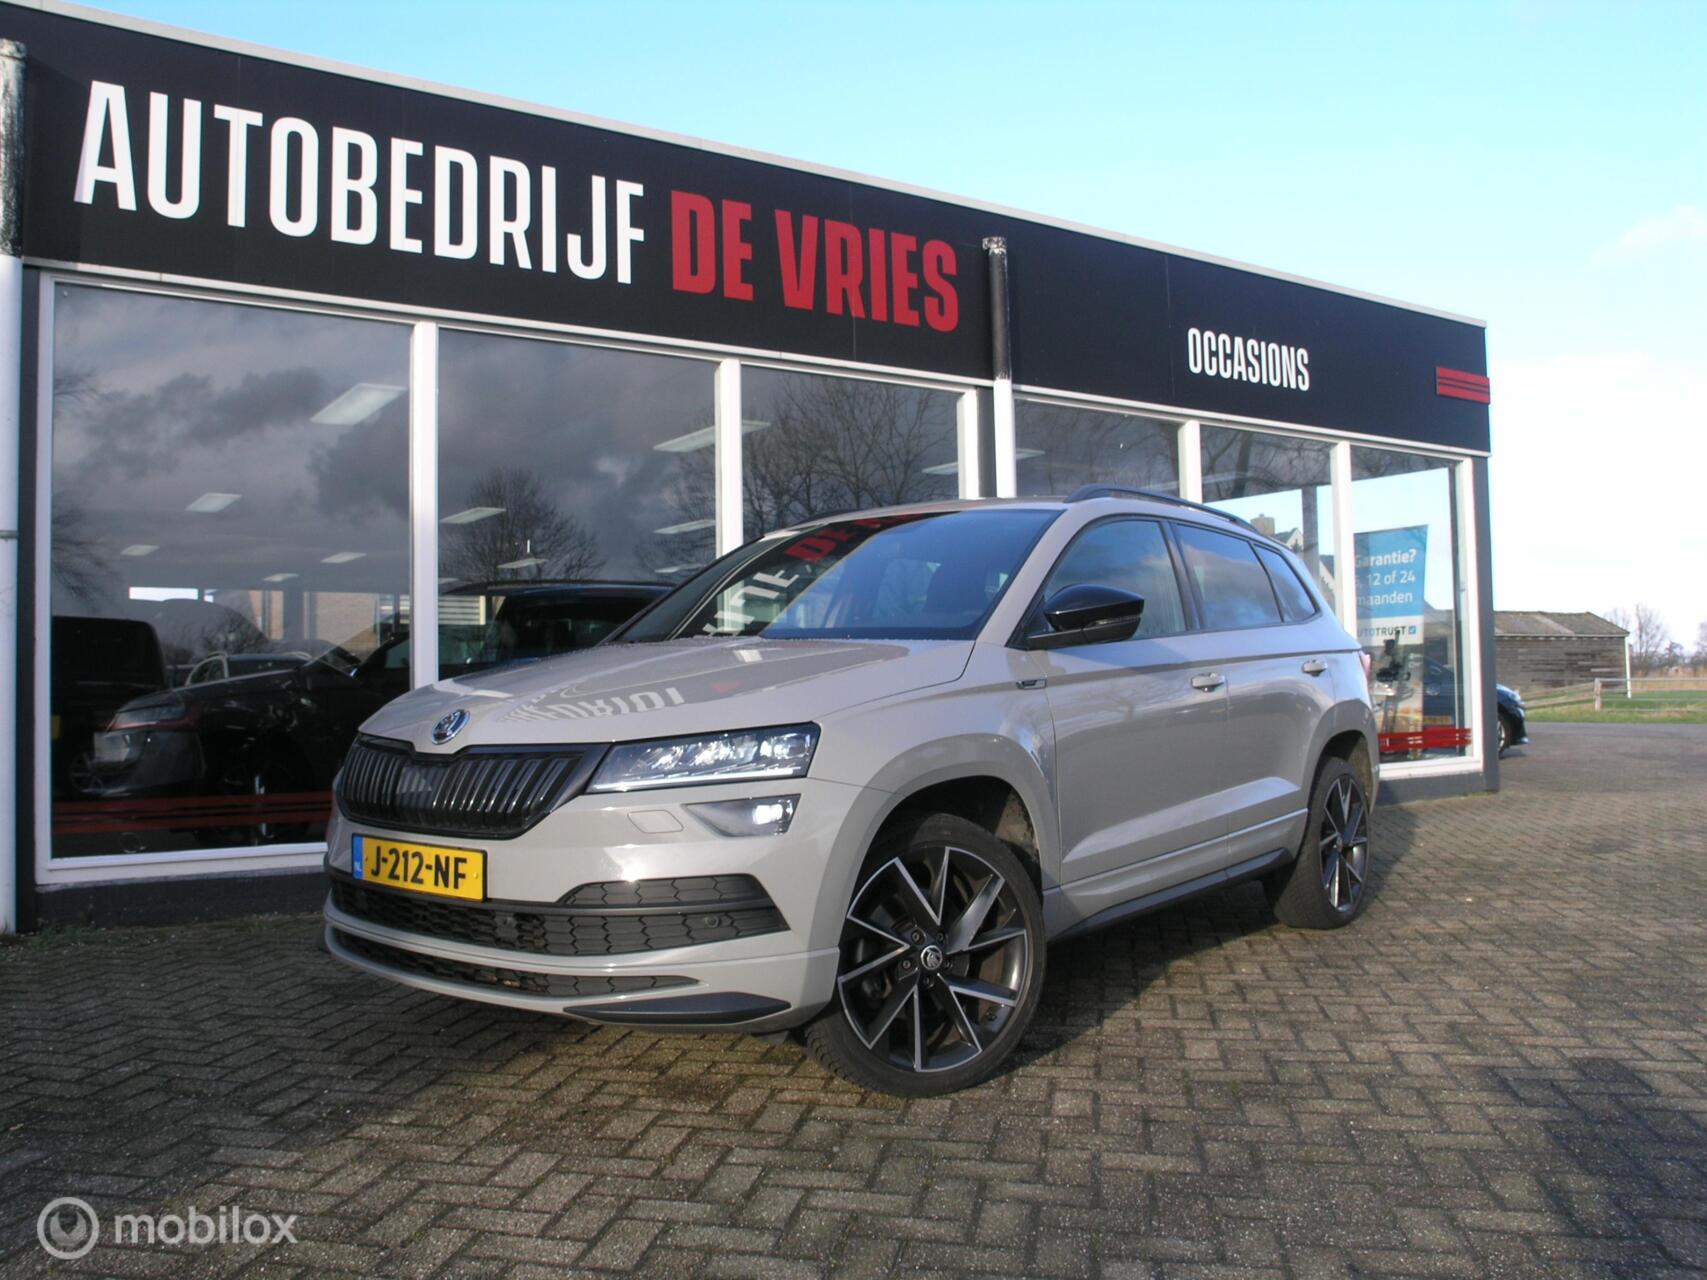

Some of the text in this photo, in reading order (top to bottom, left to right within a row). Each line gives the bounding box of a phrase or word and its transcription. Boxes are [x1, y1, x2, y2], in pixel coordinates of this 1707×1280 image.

[74, 81, 959, 332] AUTOBEDRIJF DE VRIES
[1187, 327, 1311, 392] OCCASIONS
[1367, 573, 1381, 586] 12
[1384, 569, 1397, 584] of
[1399, 569, 1416, 584] 24
[1357, 626, 1406, 637] UTOTRUST
[371, 846, 467, 889] J-212-NF
